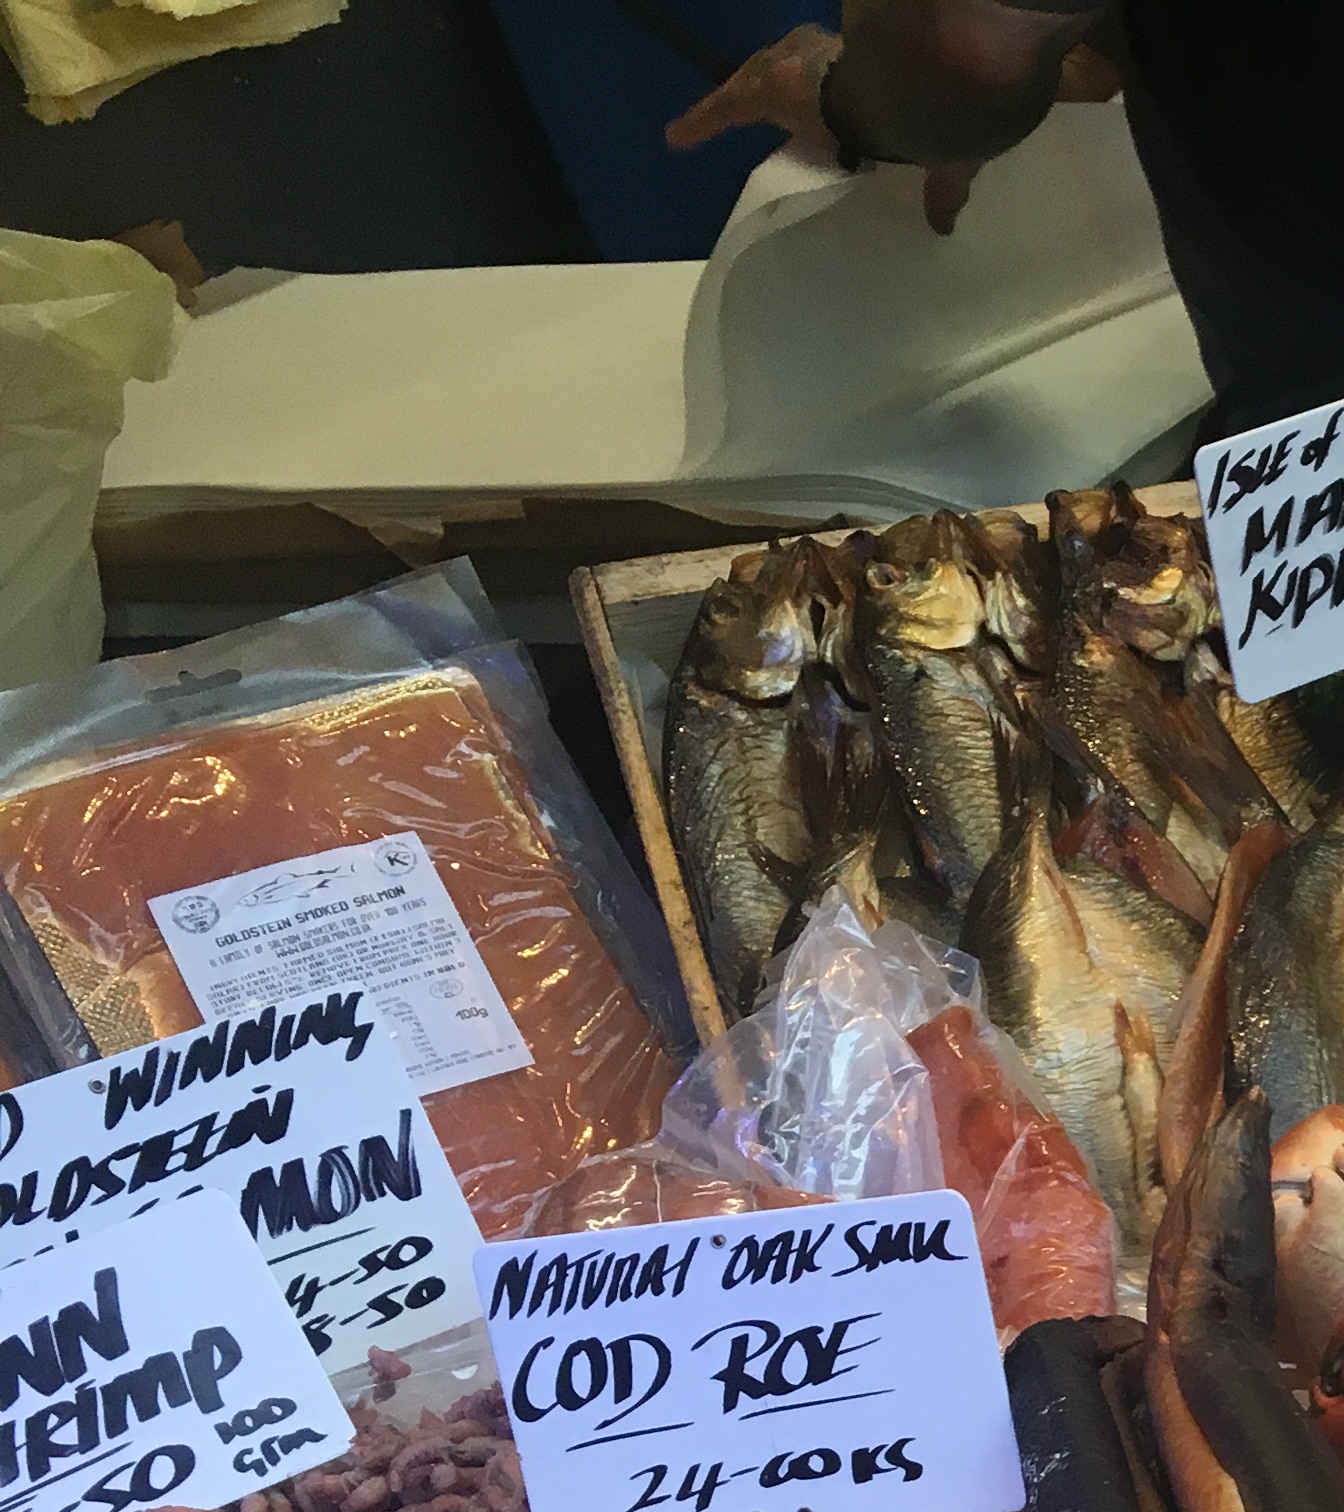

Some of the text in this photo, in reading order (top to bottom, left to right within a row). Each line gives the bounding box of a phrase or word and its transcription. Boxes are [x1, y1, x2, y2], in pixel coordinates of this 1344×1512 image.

[1206, 430, 1299, 519] ISLE
[214, 887, 406, 946] GOLDSTEIN SMOKED SALMON
[104, 990, 375, 1130] WINNING
[240, 1108, 422, 1243] MON
[488, 1237, 700, 1321] NATURAL
[720, 1223, 835, 1291] OAK
[0, 1325, 244, 1490] HRIMP
[213, 1398, 297, 1445] 100
[512, 1312, 883, 1431] COD ROE
